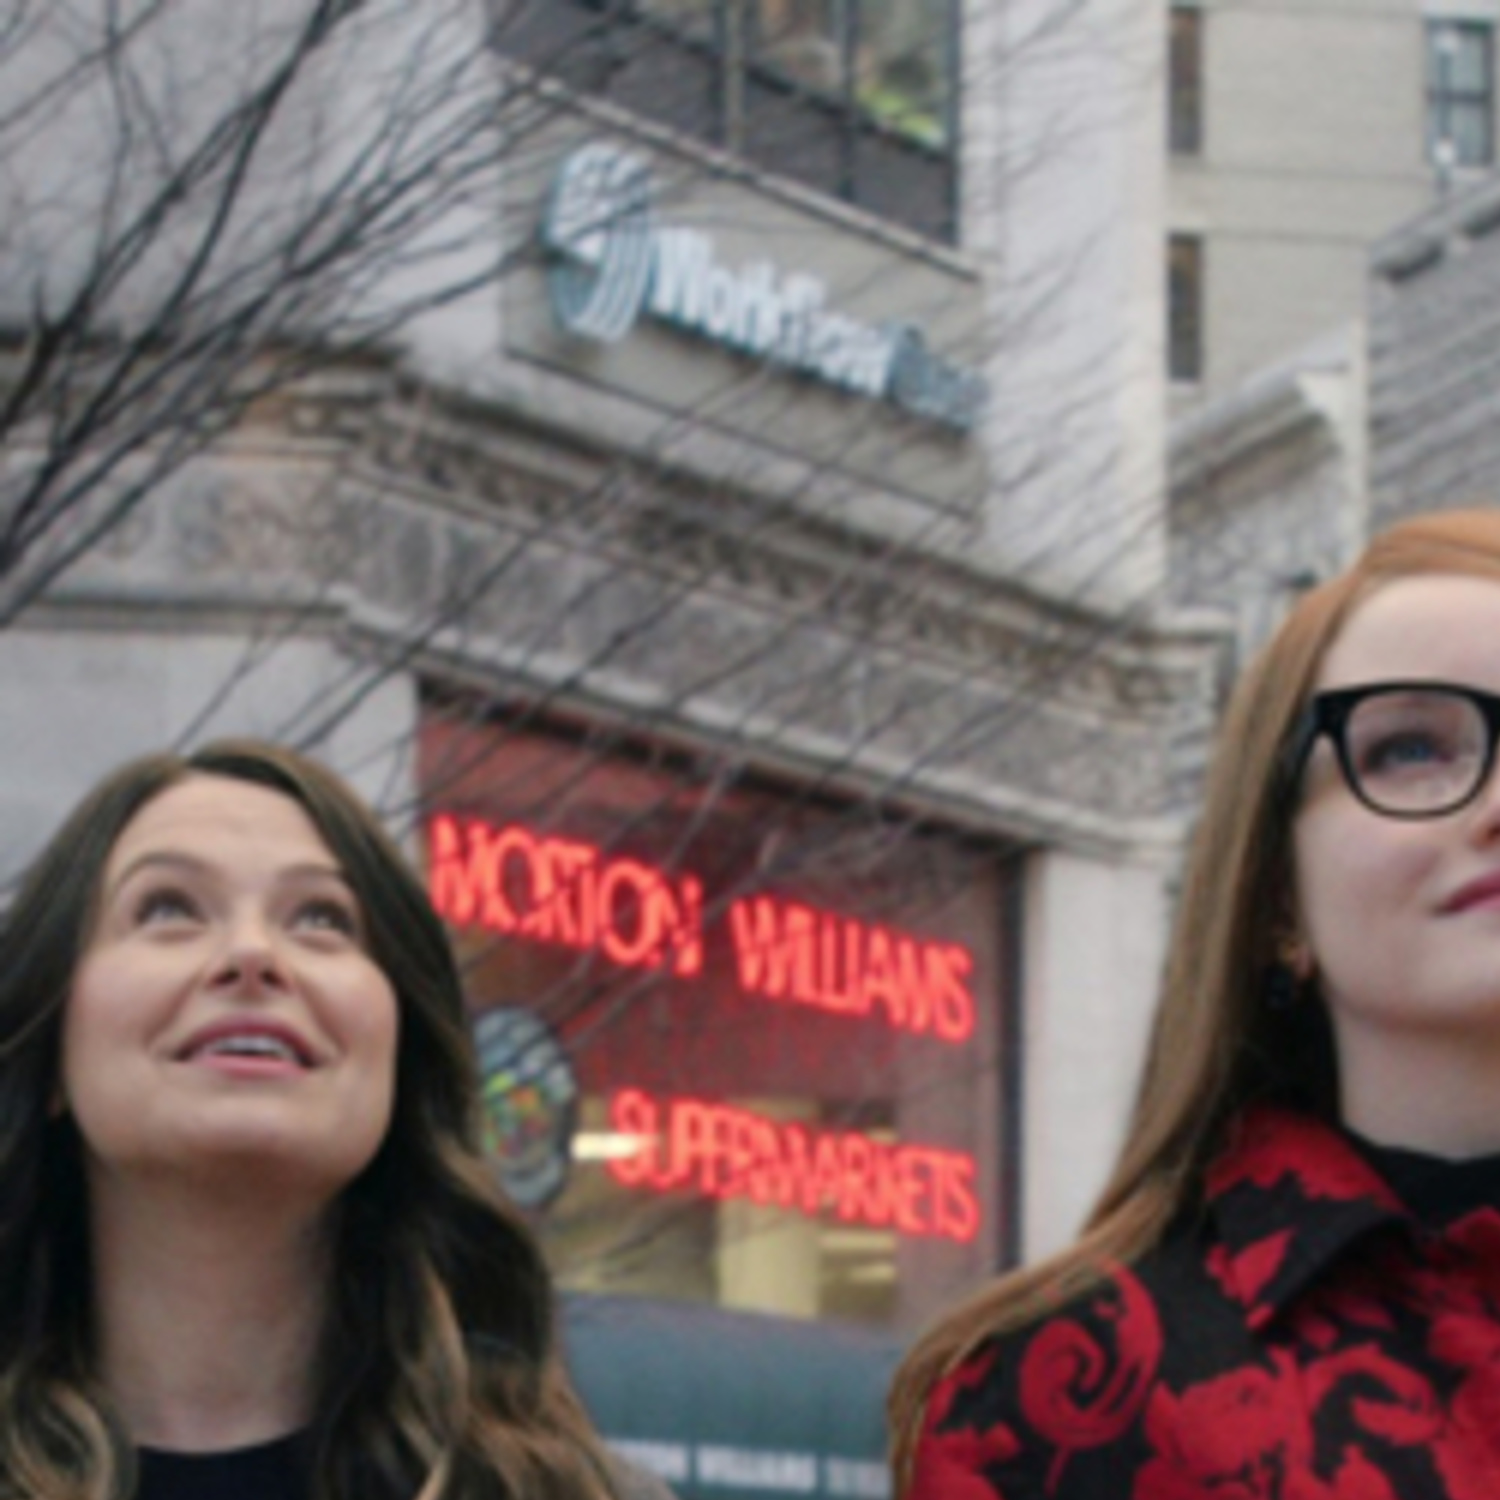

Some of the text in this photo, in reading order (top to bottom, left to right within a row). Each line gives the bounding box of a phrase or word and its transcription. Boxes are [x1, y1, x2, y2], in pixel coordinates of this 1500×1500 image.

[430, 814, 975, 1044] MORTON WILLIAMS
[607, 1086, 981, 1244] SUPERMARKETS
